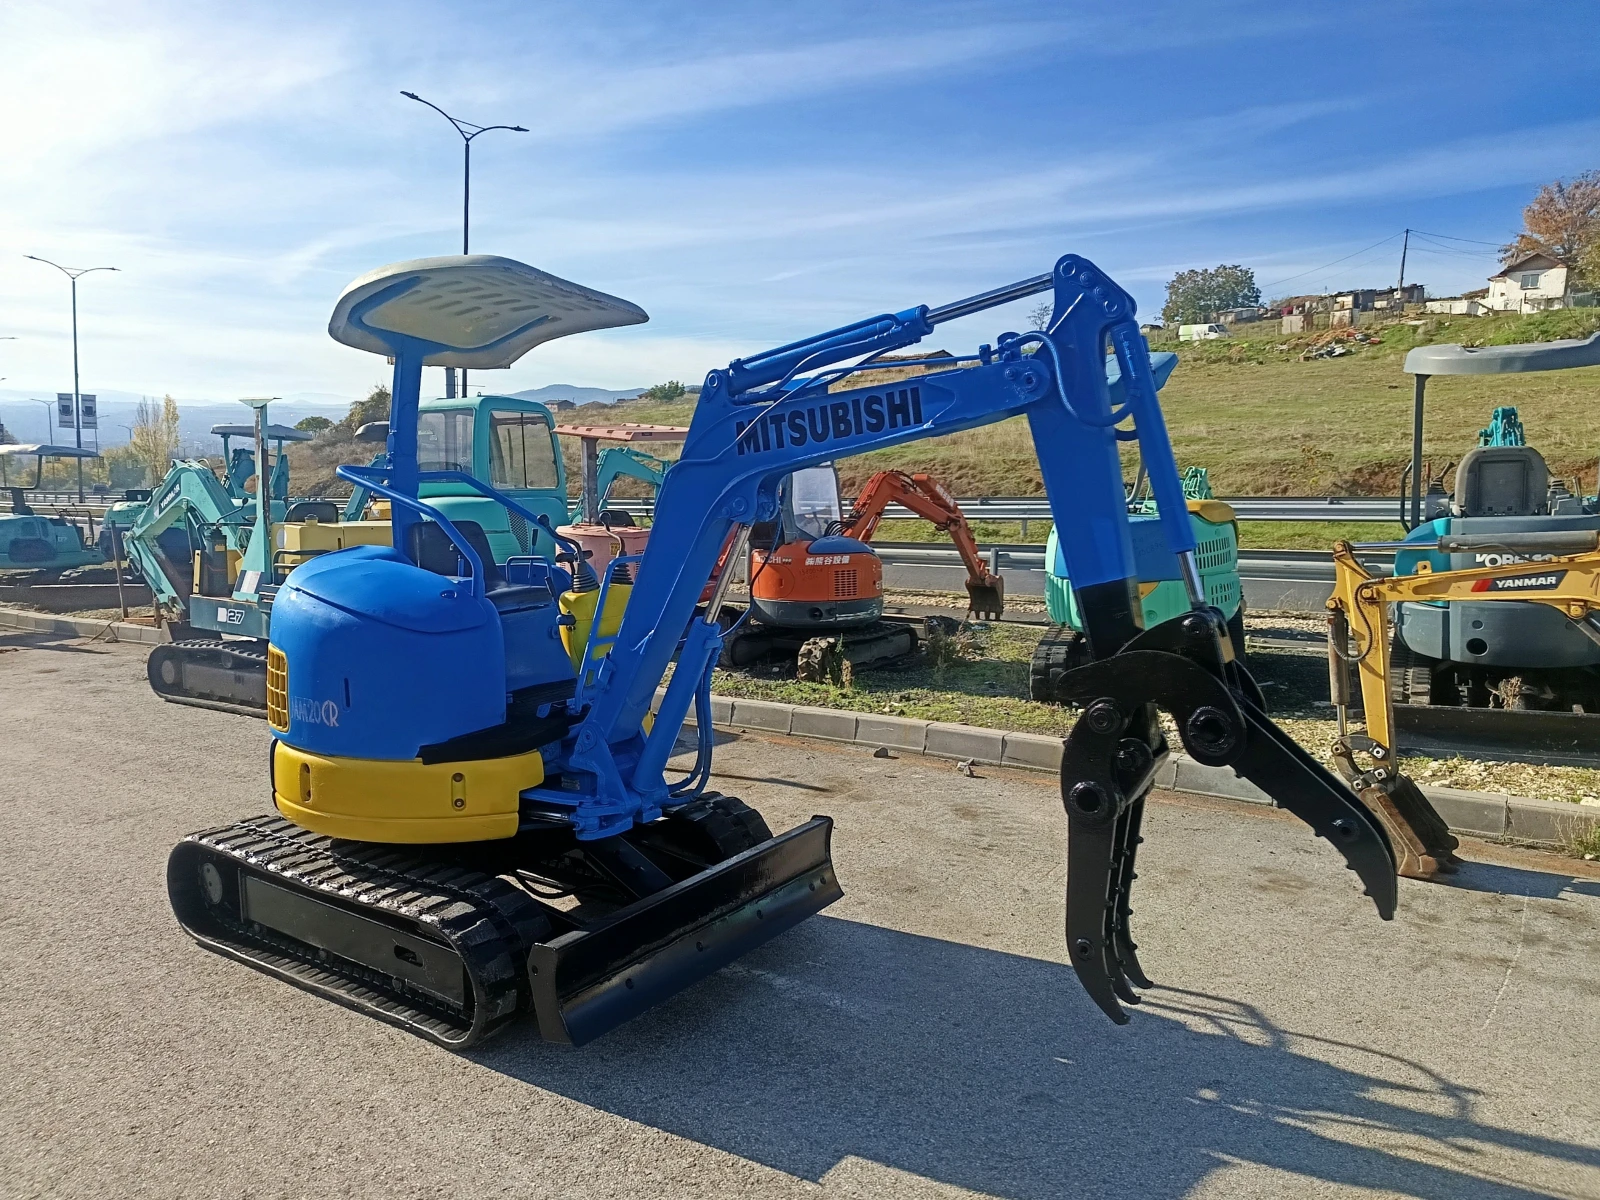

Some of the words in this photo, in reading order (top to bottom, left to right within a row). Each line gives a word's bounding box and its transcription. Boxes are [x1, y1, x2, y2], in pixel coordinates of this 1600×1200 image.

[735, 386, 923, 456] MITSUBISHI
[755, 555, 781, 564] HITCHI
[1496, 576, 1557, 588] YANMAR
